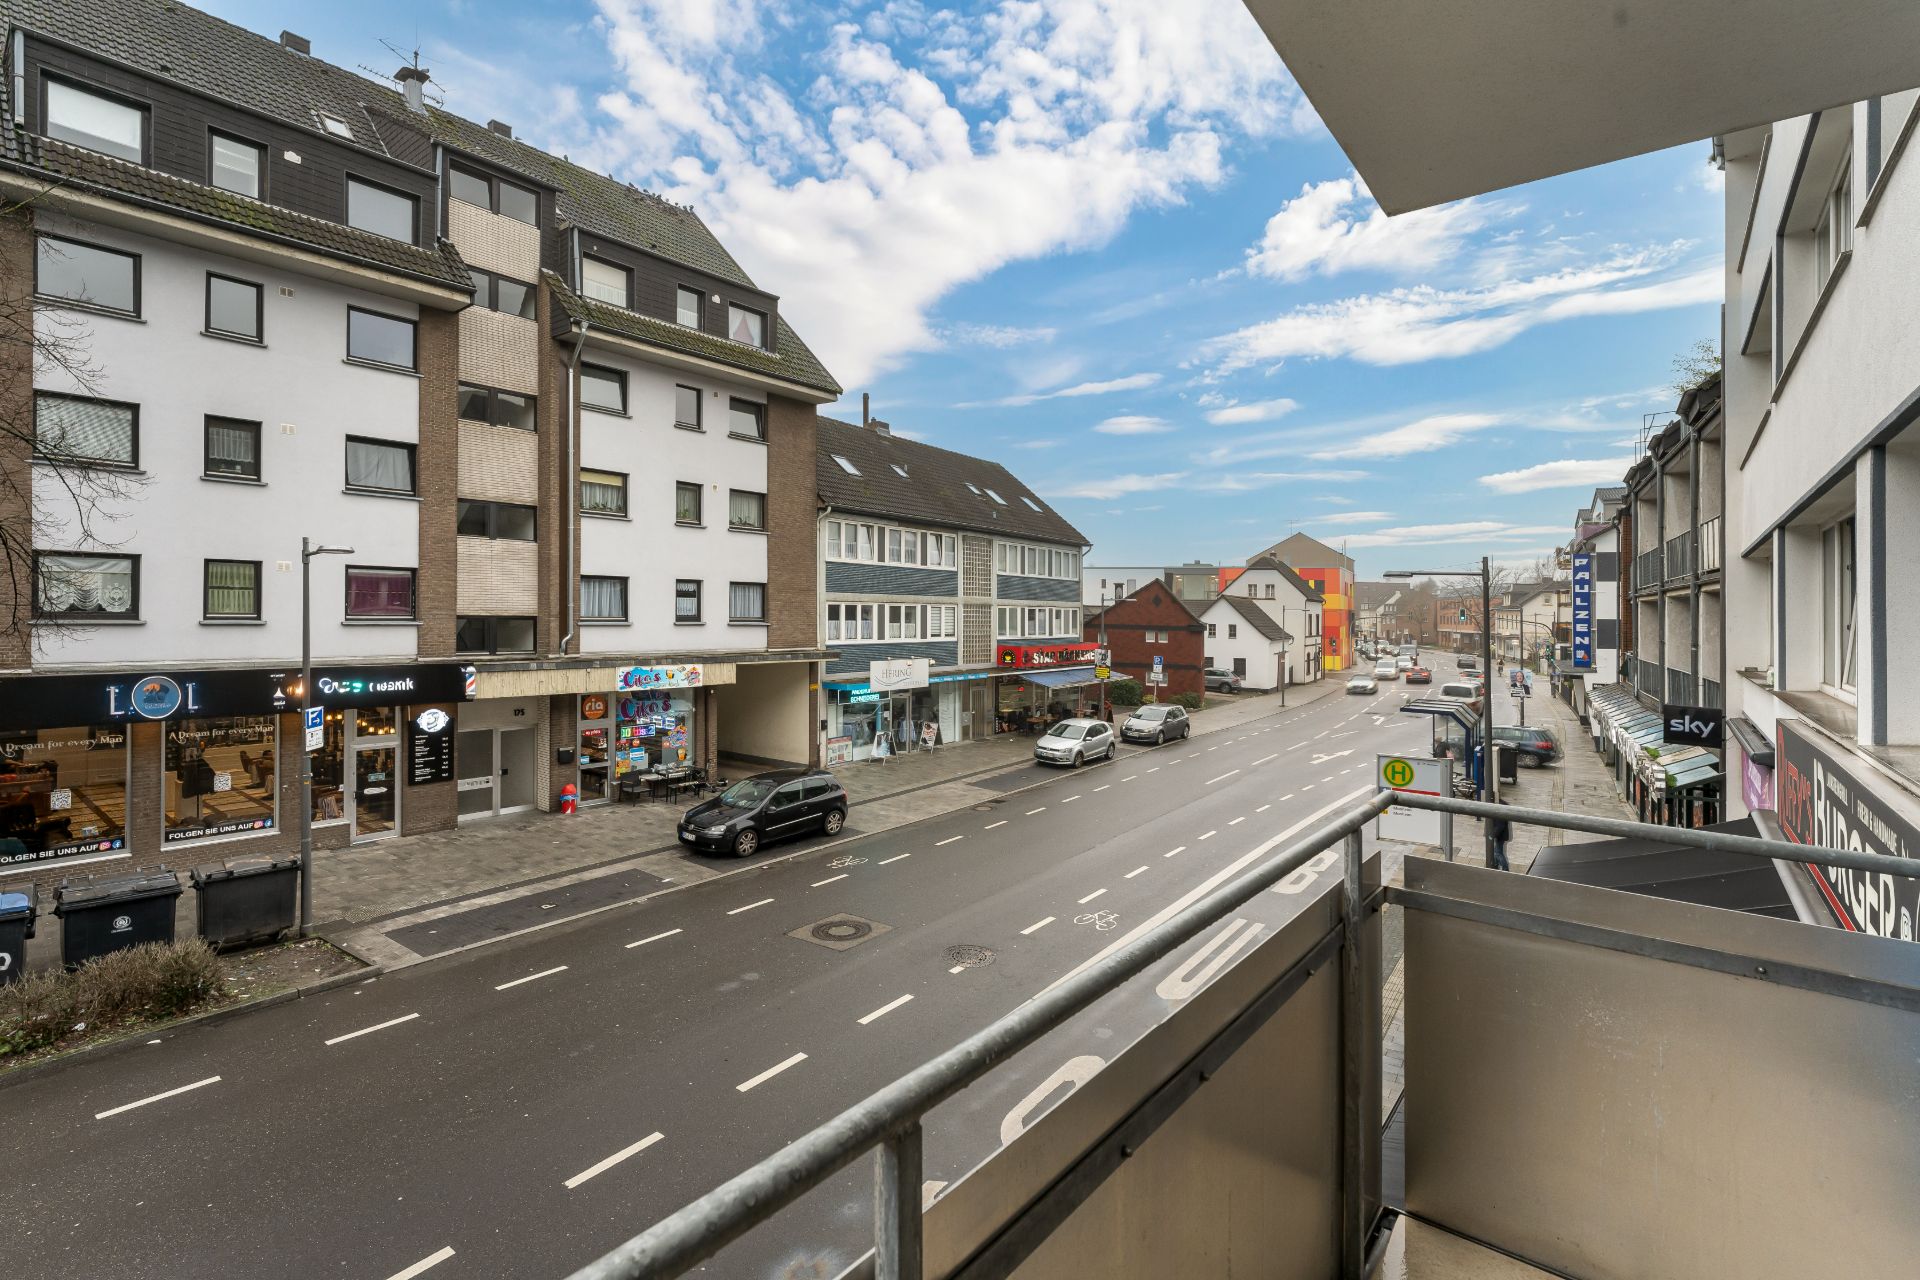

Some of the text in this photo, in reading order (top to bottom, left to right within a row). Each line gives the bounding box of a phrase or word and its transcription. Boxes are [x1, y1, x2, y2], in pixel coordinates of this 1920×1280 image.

[1574, 558, 1590, 645] PAULZEN
[585, 698, 604, 711] ria
[178, 730, 210, 740] Dream
[212, 728, 226, 738] for
[229, 727, 253, 738] every
[254, 723, 275, 737] Man
[1670, 715, 1715, 738] sky
[6, 734, 124, 754] Dream for every Man
[1391, 765, 1406, 782] H
[169, 822, 254, 840] FOLGEN SIE UNS AUF
[0, 843, 99, 864] OLGEN SIE UNS AUF
[1814, 758, 1896, 938] BURGER
